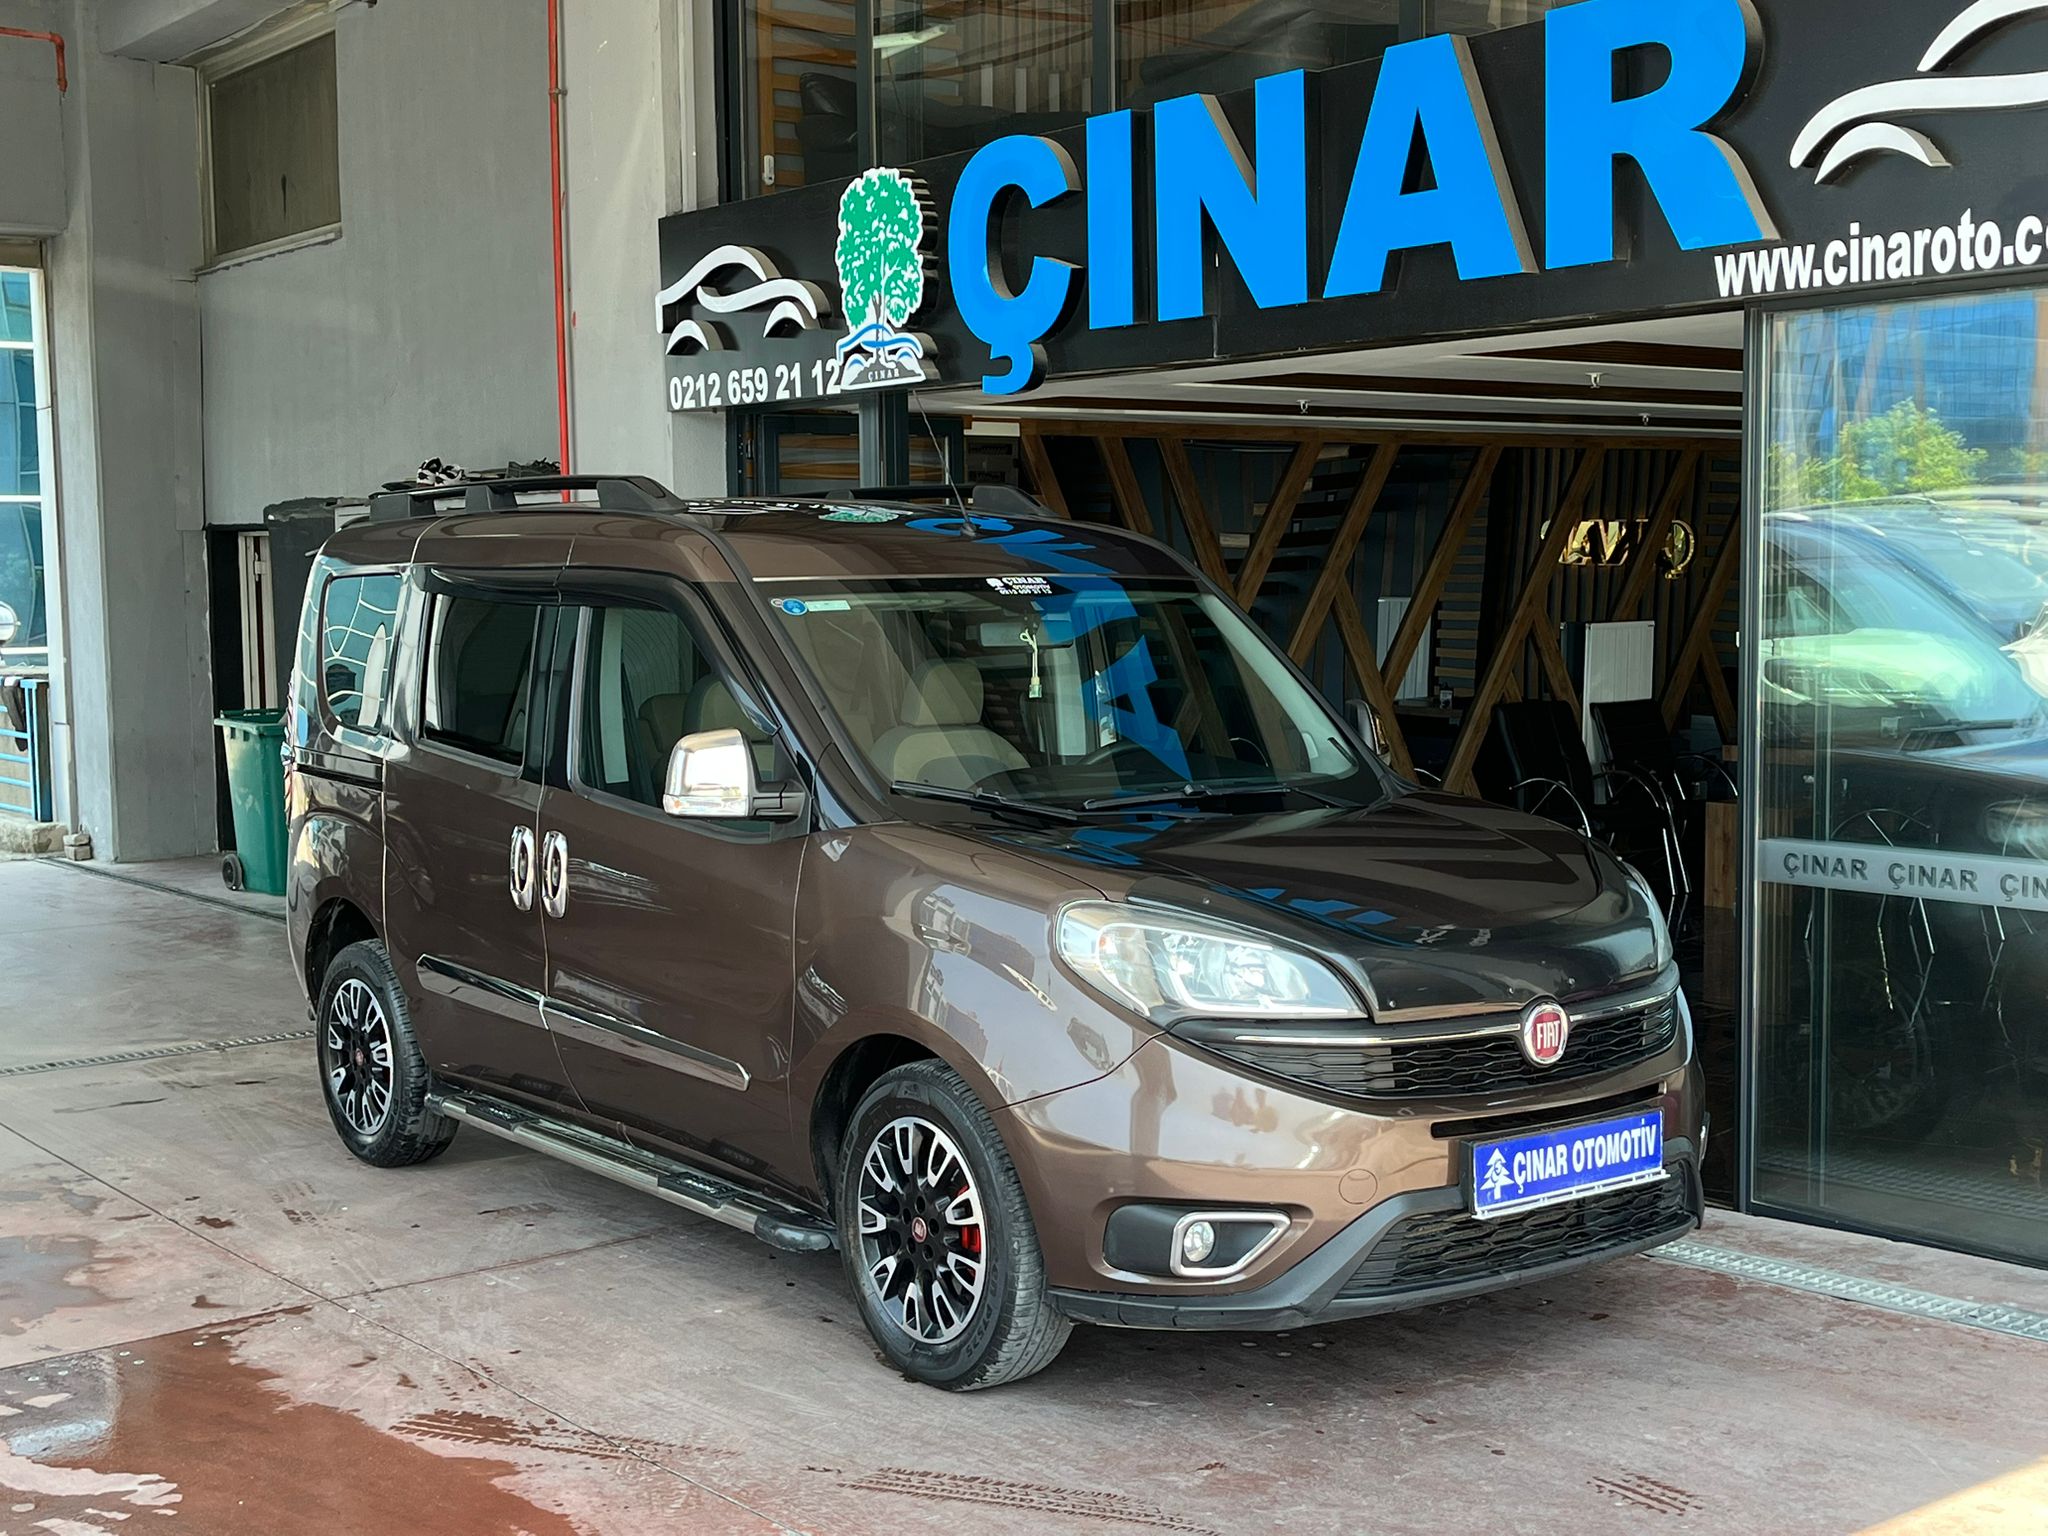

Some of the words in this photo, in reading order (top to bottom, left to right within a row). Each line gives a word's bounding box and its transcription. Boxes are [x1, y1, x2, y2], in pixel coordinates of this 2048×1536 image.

[948, 0, 1764, 395] ÇINAR
[1713, 207, 2048, 298] www.cinaroto.c
[669, 372, 722, 410] 0212
[727, 366, 769, 405] 659
[775, 361, 802, 400] 21
[811, 358, 841, 396] 12
[867, 368, 900, 383] ÇINAR
[1783, 852, 1868, 881] ÇINAR
[1888, 862, 1978, 892] ÇINAR
[1536, 1020, 1561, 1050] FIAT
[1513, 1144, 1568, 1195] ÇINAR
[1572, 1117, 1657, 1173] OTOMOTİV
